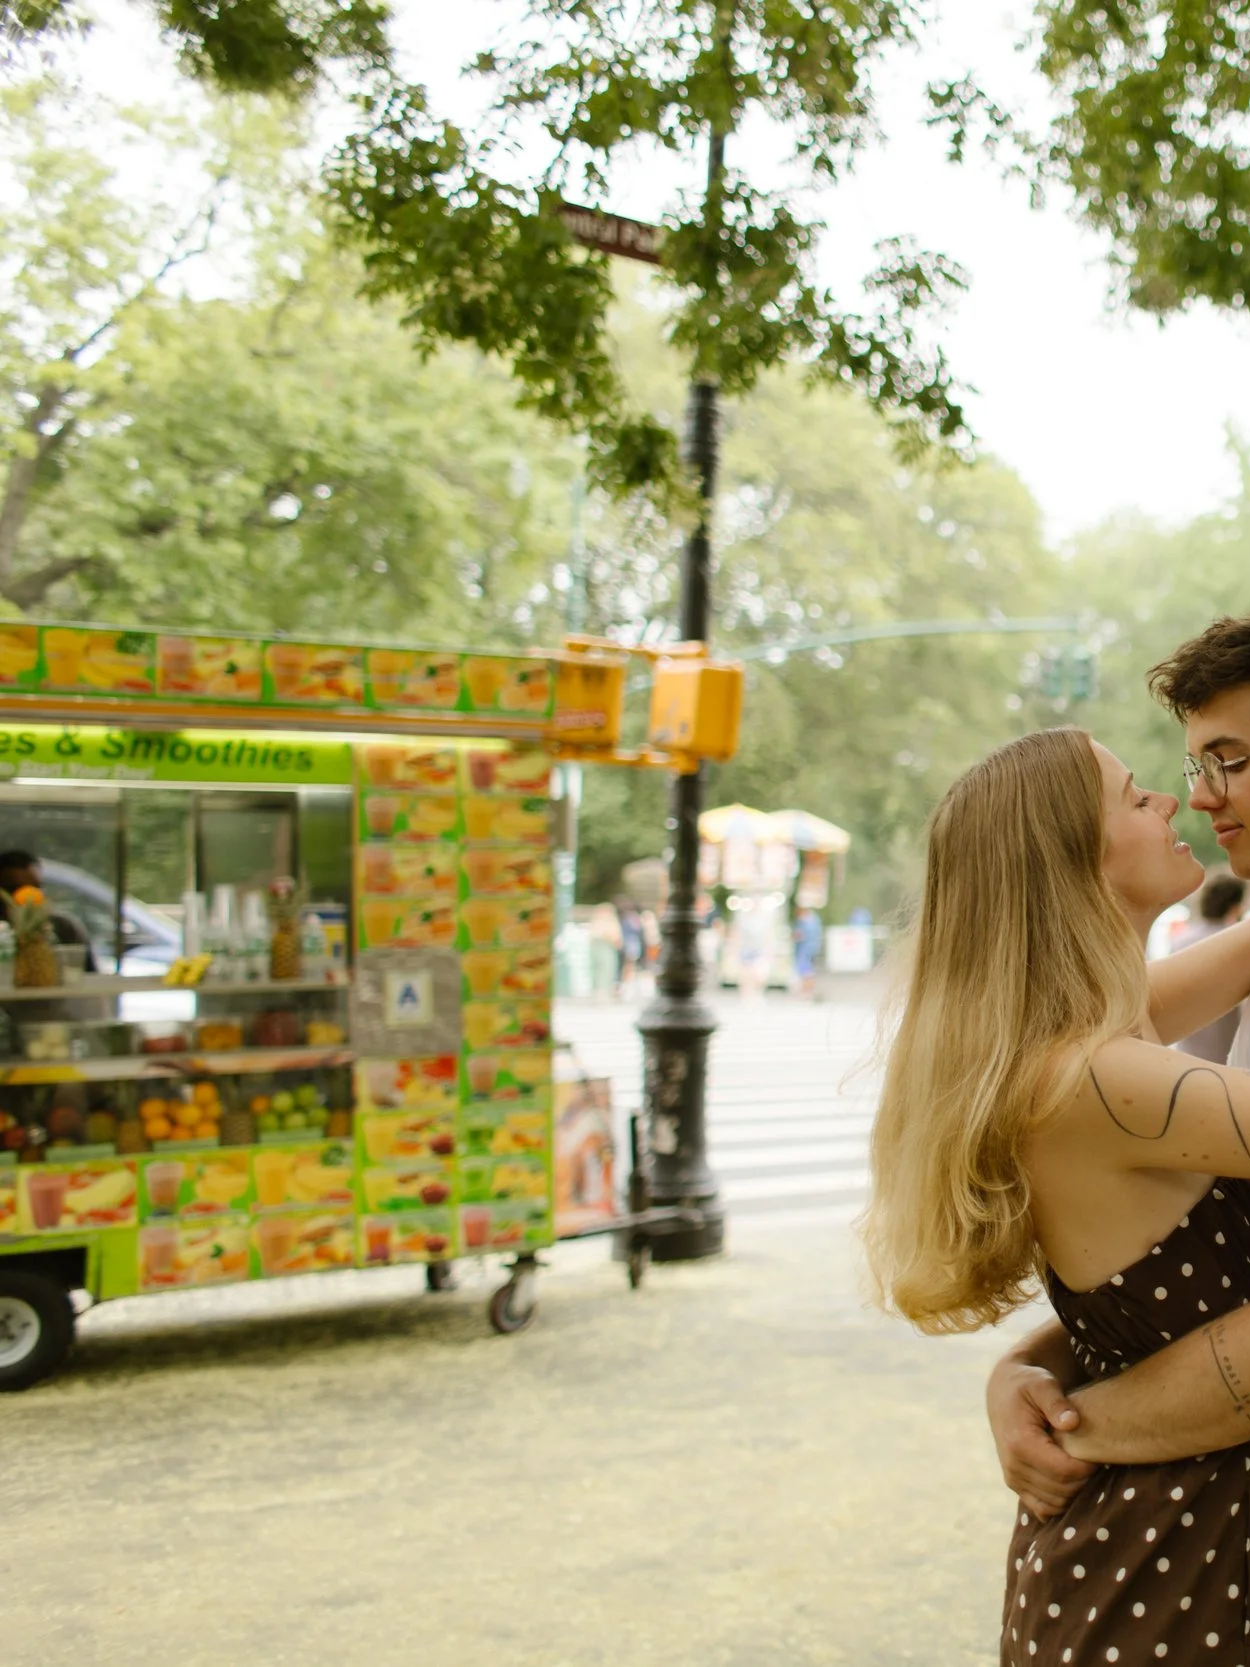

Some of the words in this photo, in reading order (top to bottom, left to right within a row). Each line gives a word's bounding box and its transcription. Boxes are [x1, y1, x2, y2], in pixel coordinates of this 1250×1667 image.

[54, 728, 82, 757] &
[100, 730, 314, 772] Smoothies
[397, 983, 420, 1009] A
